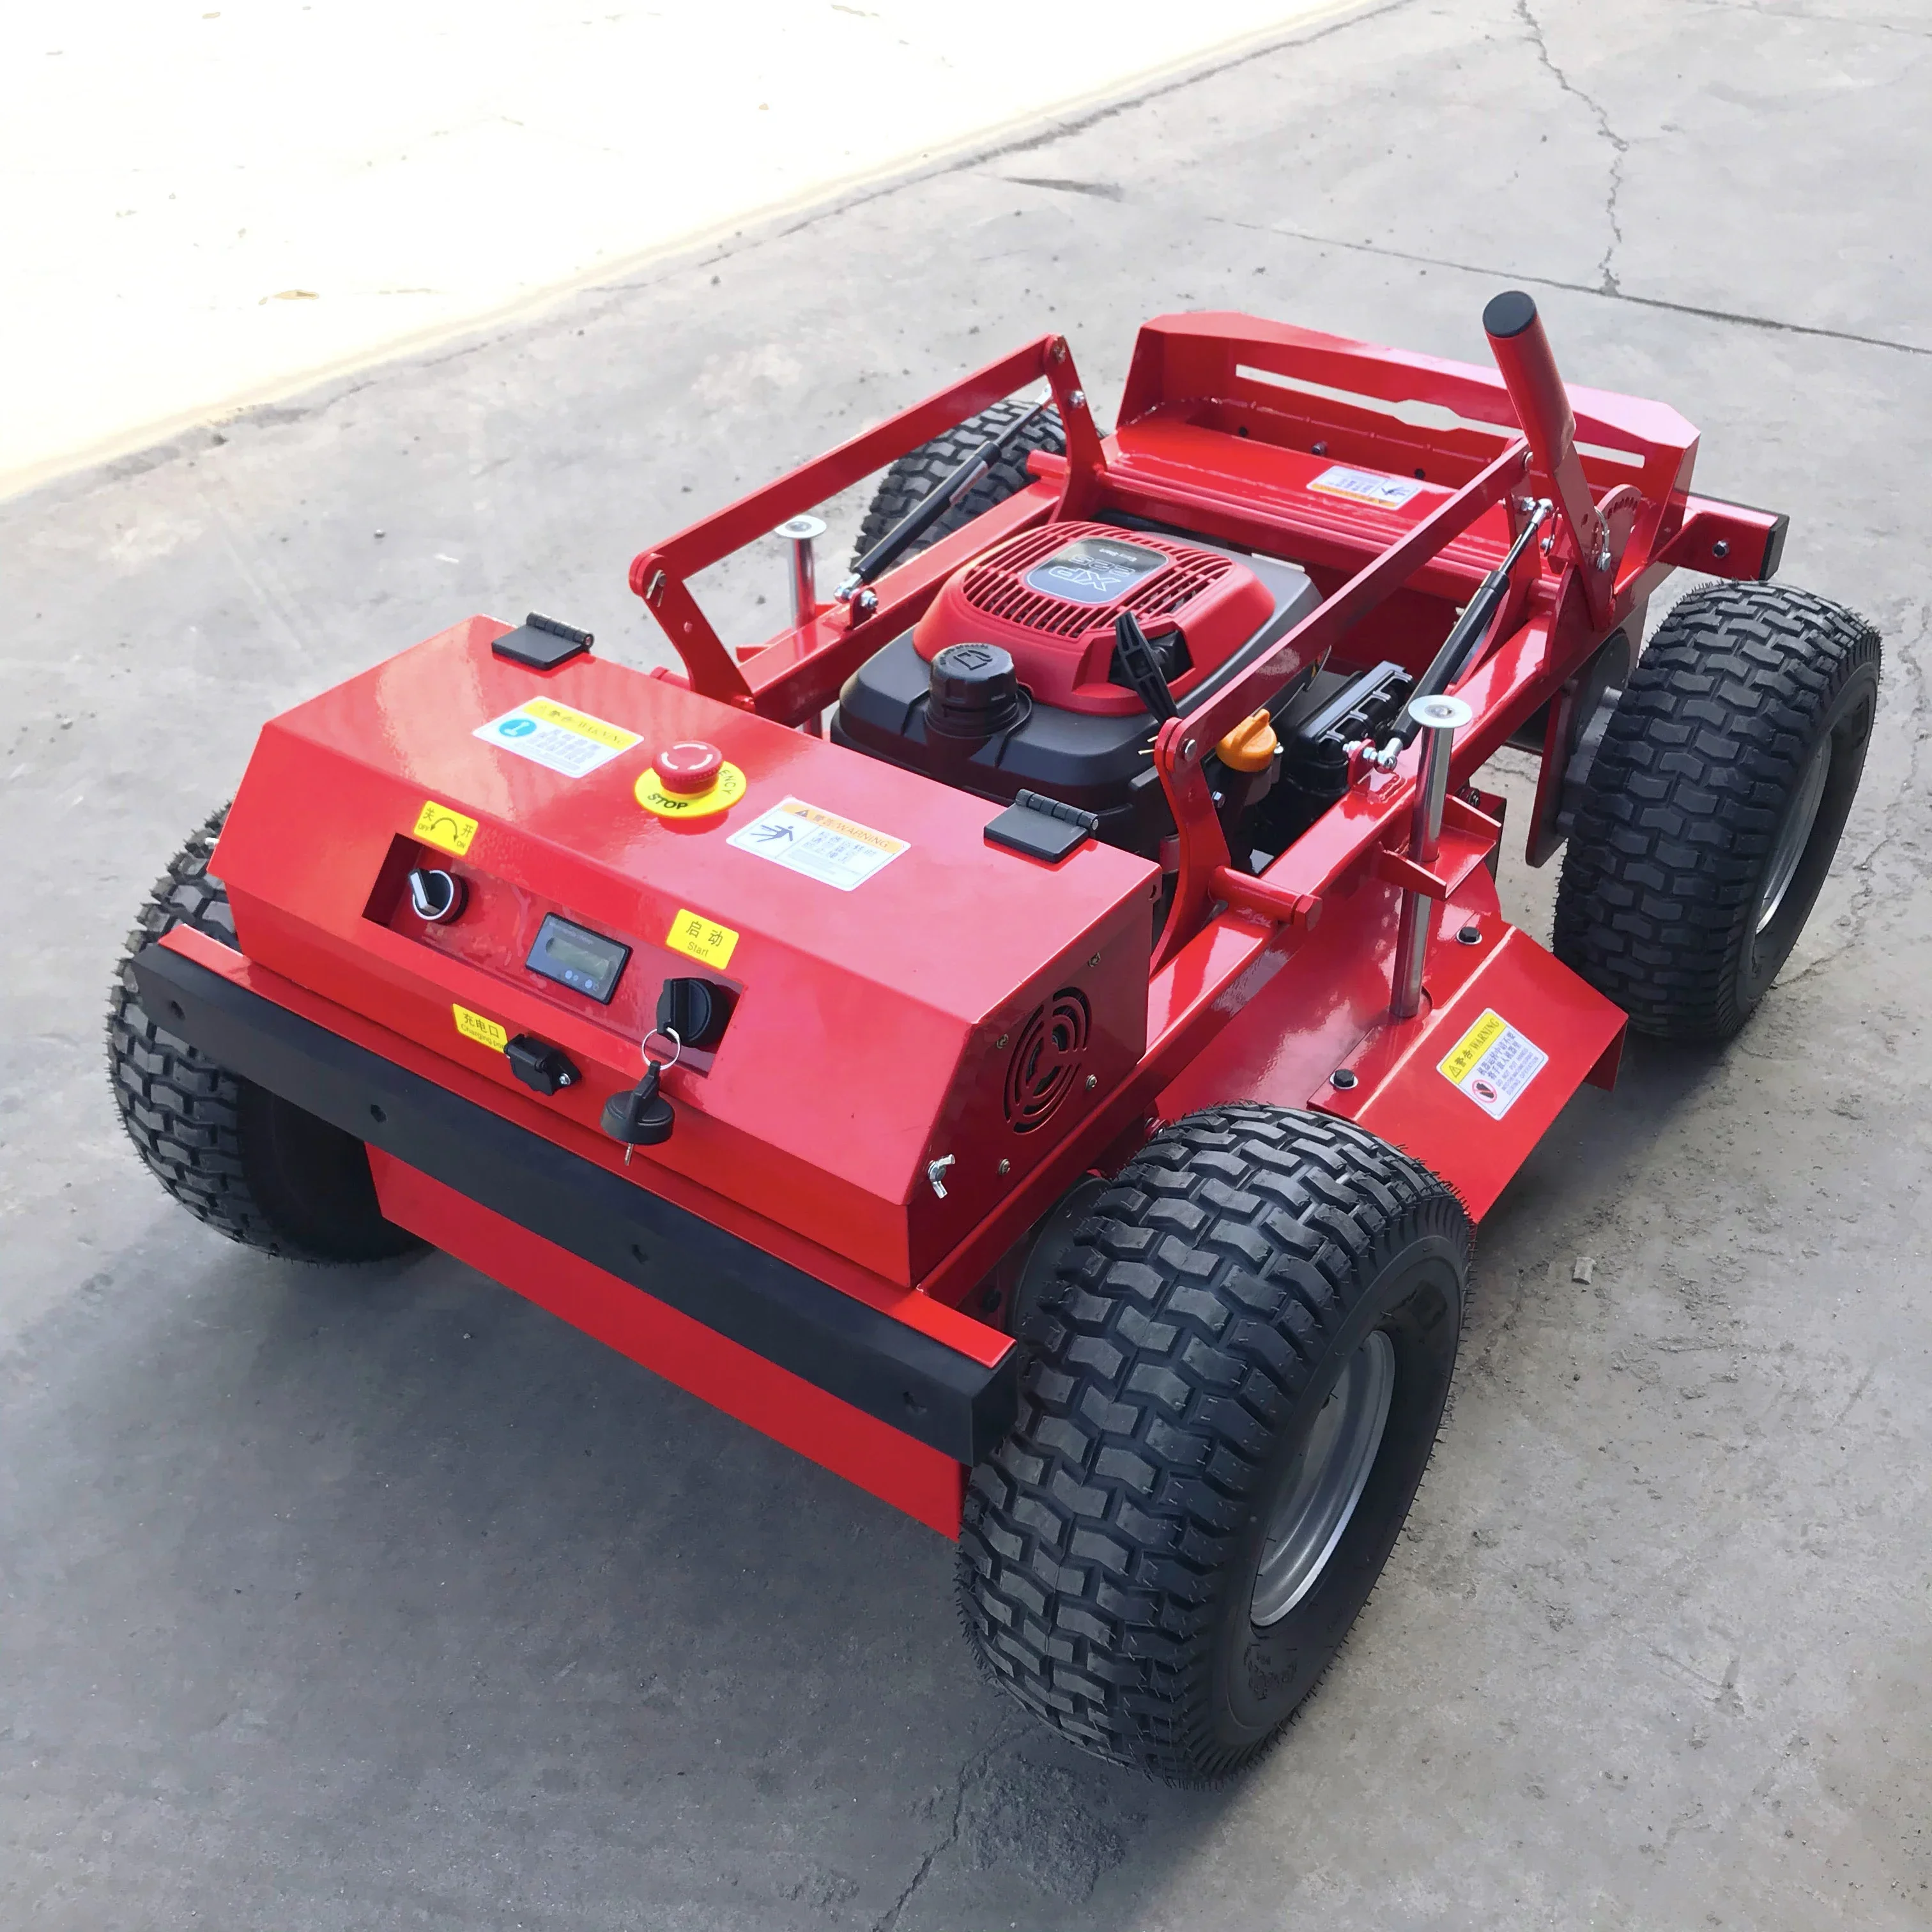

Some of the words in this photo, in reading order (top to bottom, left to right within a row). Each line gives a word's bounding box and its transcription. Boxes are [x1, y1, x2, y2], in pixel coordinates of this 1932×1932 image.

[1068, 554, 1135, 577] 225
[1049, 566, 1121, 592] XP
[647, 793, 688, 809] STOP
[423, 808, 435, 822] 关
[461, 824, 473, 838] 开
[838, 822, 889, 848] WARNING
[456, 840, 466, 848] ON
[686, 921, 723, 947] 启动
[687, 941, 709, 957] Start
[461, 1023, 492, 1045] Charging
[463, 1012, 499, 1038] 充电口
[1469, 1018, 1499, 1050] WARNING
